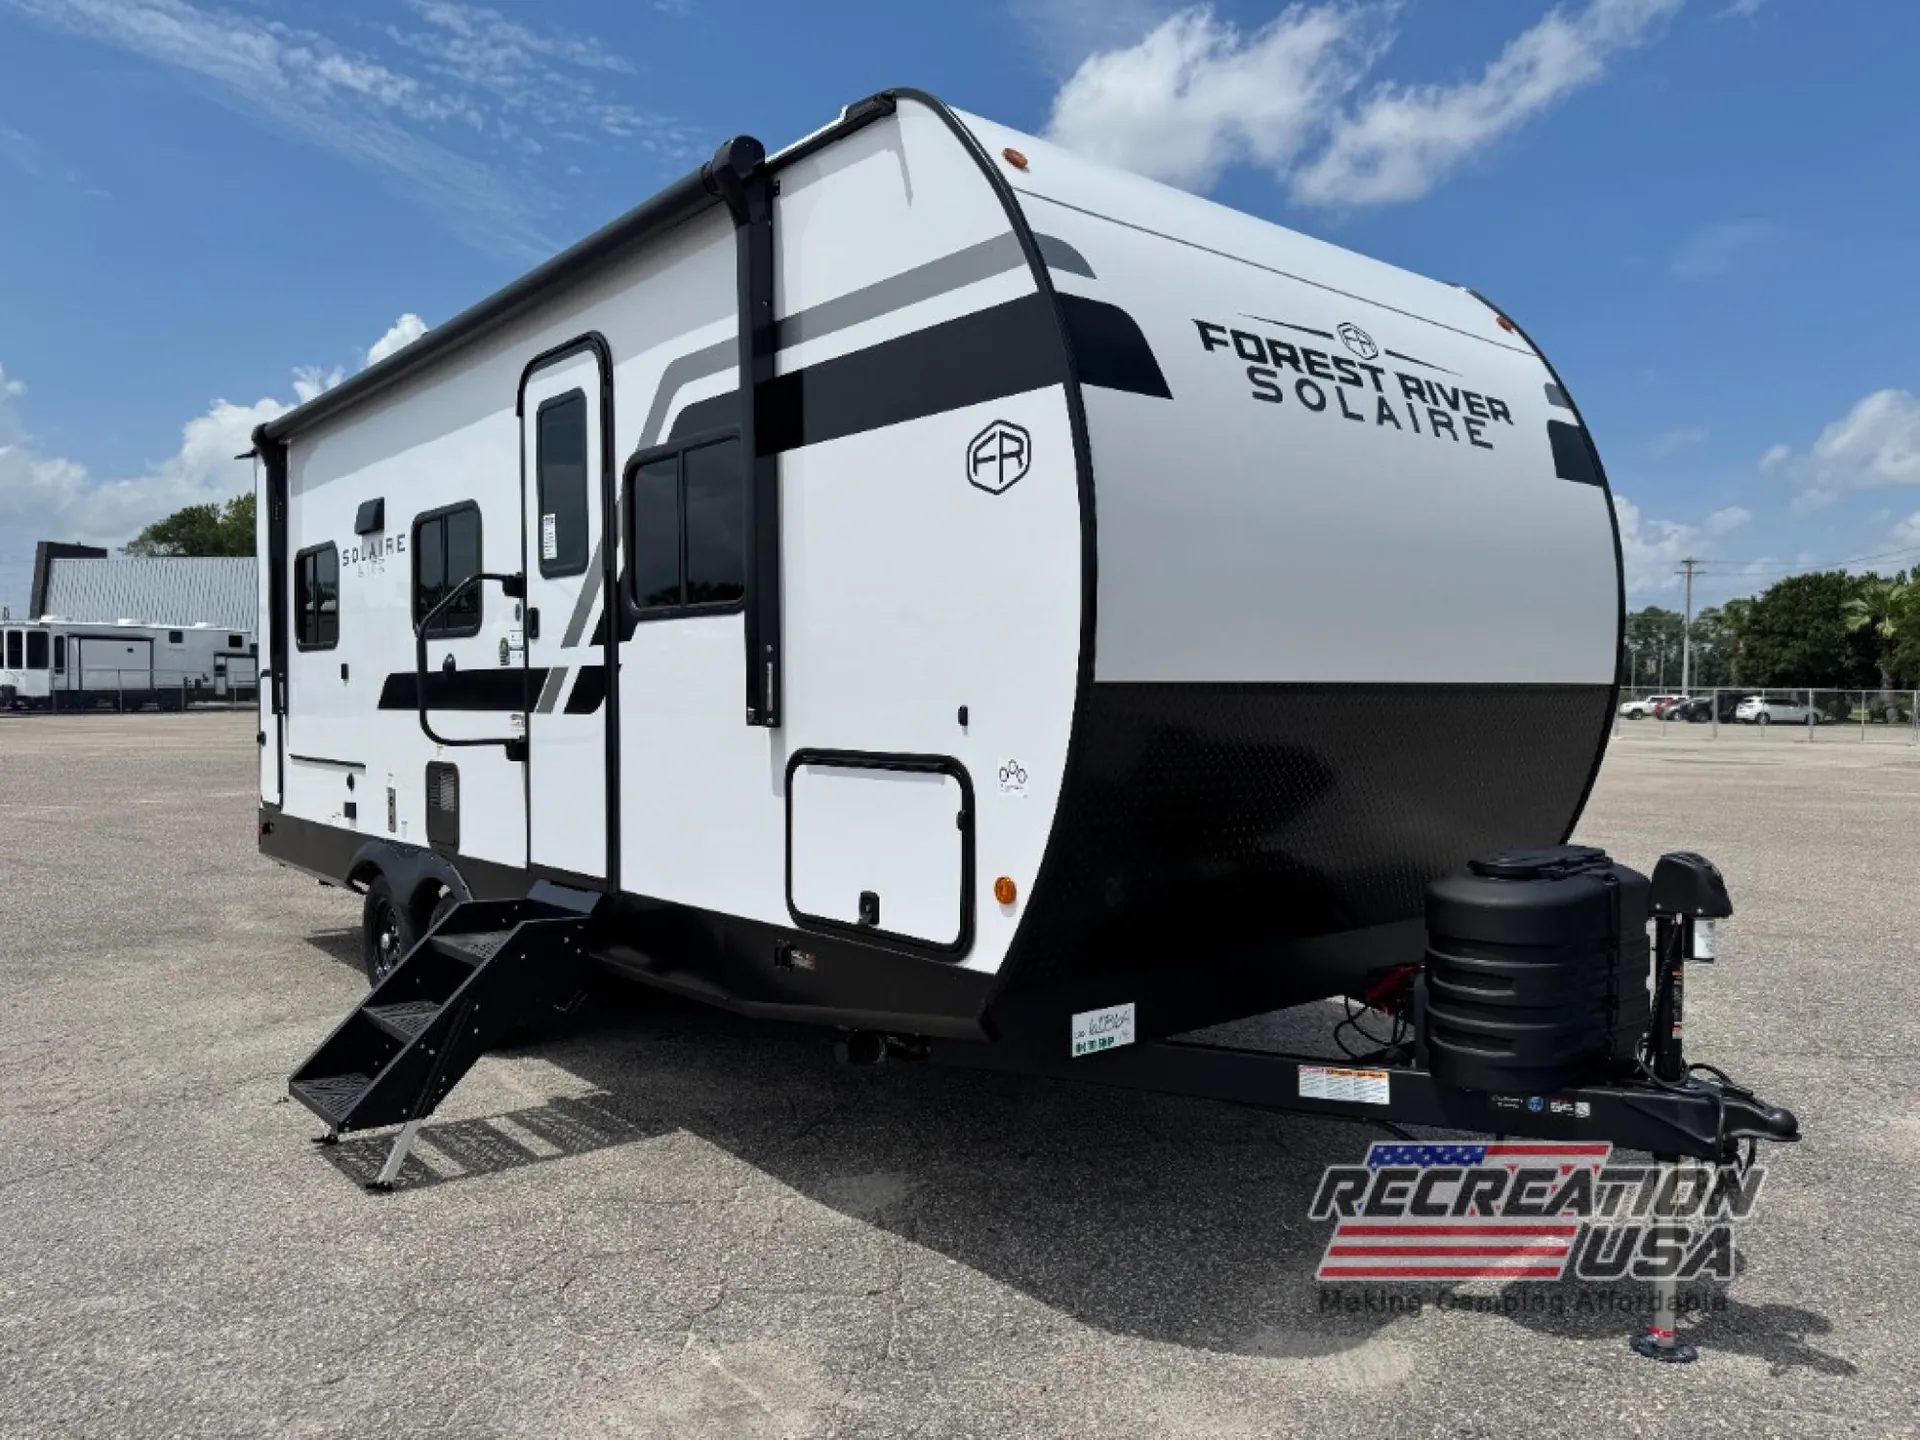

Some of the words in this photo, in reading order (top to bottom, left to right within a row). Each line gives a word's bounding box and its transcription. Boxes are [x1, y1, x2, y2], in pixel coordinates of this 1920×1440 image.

[1191, 318, 1385, 392] FOREST
[1394, 370, 1514, 426] RIVER
[1246, 365, 1494, 450] SOLAIRE
[342, 533, 406, 567] SOLAIRE
